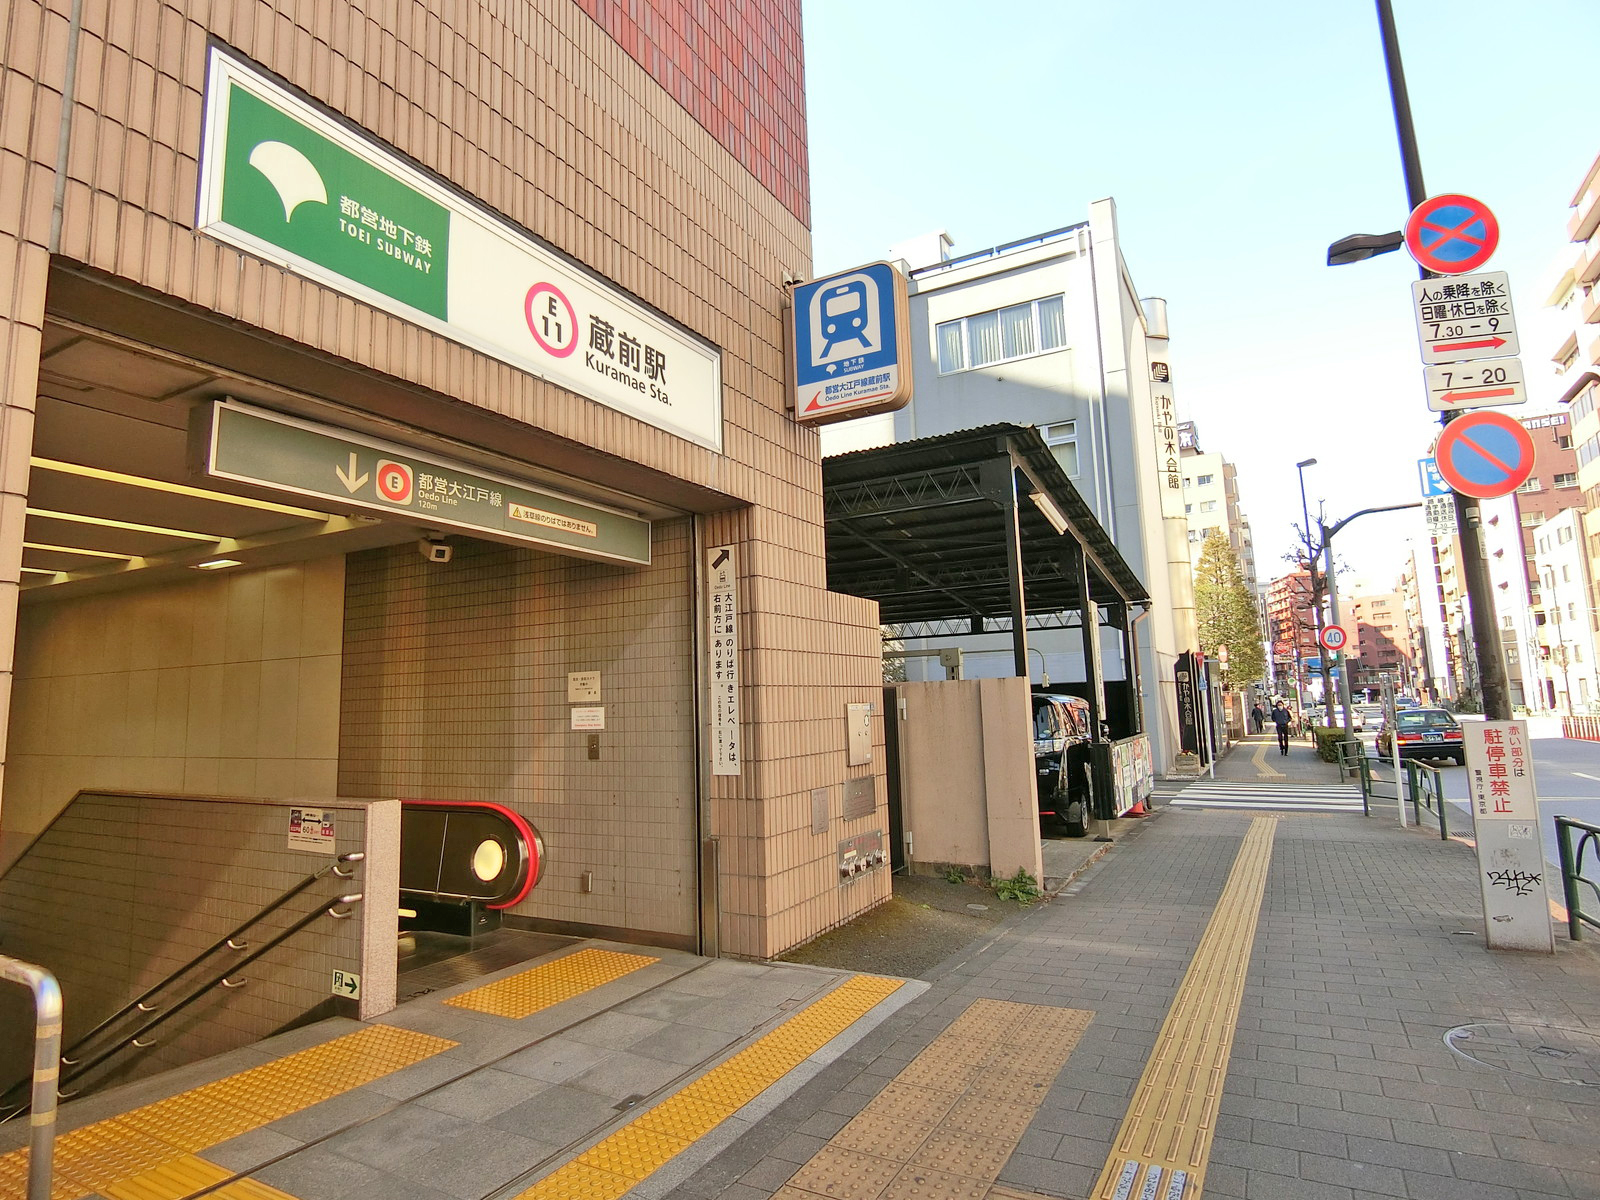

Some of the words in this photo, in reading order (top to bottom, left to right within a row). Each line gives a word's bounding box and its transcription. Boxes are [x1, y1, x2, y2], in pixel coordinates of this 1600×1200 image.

[340, 194, 433, 258] 都営地下鉄
[339, 218, 371, 245] TOEI
[376, 237, 432, 274] SUBWAY
[1419, 281, 1506, 303] 人の乗降を除く
[547, 295, 557, 316] E
[1421, 300, 1510, 321] 日曜・休日を除く
[541, 314, 564, 344] 11
[1430, 323, 1464, 339] 7.30
[1488, 317, 1500, 333] 9
[588, 313, 667, 385] 蔵前駅
[584, 351, 647, 393] Kuramae
[648, 384, 673, 407] Sta.
[843, 363, 865, 373] SUBWAY
[1441, 372, 1453, 389] 7
[1482, 367, 1506, 384] 20
[825, 372, 891, 395] 都営大江戸線蔵前駅
[825, 393, 840, 402] Oedo
[840, 390, 853, 399] Line
[853, 386, 879, 396] Kuramae
[879, 383, 890, 391] Sta.
[1160, 394, 1180, 489] かやの木会館
[391, 475, 399, 489] E
[419, 472, 502, 507] 都営大江戸線
[418, 489, 440, 502] Oedo
[441, 495, 458, 506] Line
[418, 500, 438, 511] 120m
[522, 509, 594, 534] 浅草線のりばではありません。
[713, 593, 724, 688] 右前方にあります。
[1326, 632, 1341, 644] 40
[724, 592, 737, 767] 大江戸線のりば行きエレベータは、
[1508, 725, 1525, 777] 赤い部分は
[1483, 728, 1513, 813] 駐停車禁止
[1474, 769, 1488, 815] 警視庁・東京都
